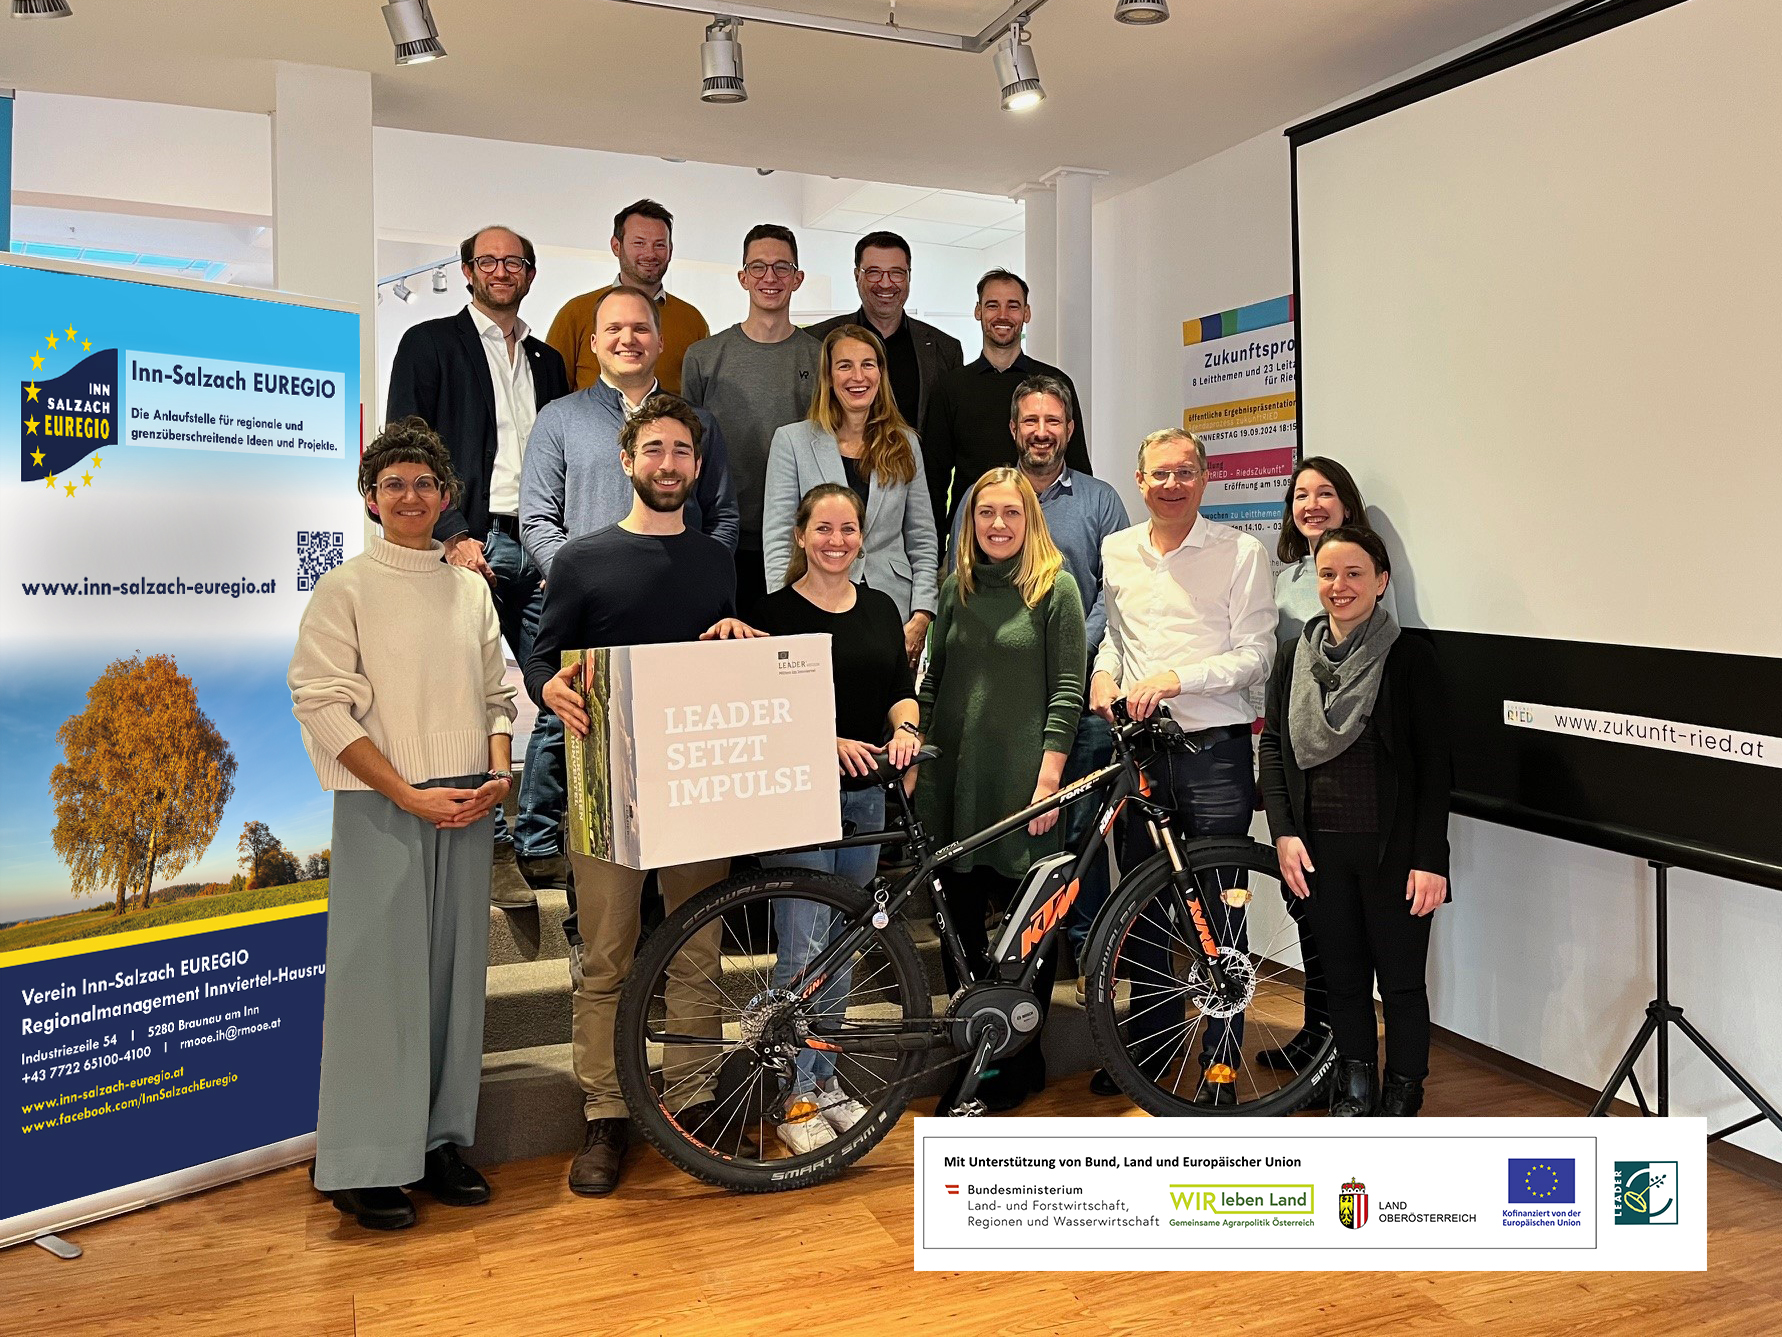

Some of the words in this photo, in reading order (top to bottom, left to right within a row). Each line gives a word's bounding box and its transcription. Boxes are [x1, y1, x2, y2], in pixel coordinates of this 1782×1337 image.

[1204, 339, 1295, 368] Zukunftspro
[89, 382, 110, 396] INN
[132, 360, 246, 391] Inn-Salzach
[254, 372, 336, 399] EUREGIO
[1192, 378, 1197, 387] 8
[1200, 371, 1243, 386] Leitthemen
[1246, 366, 1261, 377] und
[1264, 364, 1274, 374] 23
[1264, 376, 1278, 385] für
[47, 397, 110, 414] SALZACH
[131, 408, 149, 420] Die
[153, 409, 216, 426] Anlaufstelle
[219, 414, 234, 427] für
[236, 416, 282, 431] regionale
[285, 419, 303, 432] und
[1188, 410, 1222, 422] öffentliche
[45, 415, 110, 440] EUREGIO
[131, 428, 244, 445] grenzüberschreitende
[247, 433, 273, 447] Ideen
[277, 437, 295, 449] und
[298, 438, 338, 453] Projekte.
[1199, 430, 1238, 442] ONNERSTAG
[1240, 425, 1277, 438] 19.09.2024
[1224, 481, 1258, 491] Eröffnung
[1241, 509, 1281, 519] Leitthemen
[22, 577, 276, 598] www.inn-salzach-euregio.at
[778, 661, 806, 669] LEADER
[664, 697, 792, 735] LEADER
[1508, 710, 1533, 723] RIED
[1554, 714, 1764, 758] www.zukunft-ried.at
[666, 734, 768, 771] SETZT
[668, 764, 812, 807] IMPULSE
[682, 881, 794, 929] SCHWALBE
[1021, 877, 1080, 960] KTM
[1098, 900, 1136, 1003] SCHWALBE
[22, 983, 77, 1006] Verein
[83, 963, 175, 996] Inn-Salzach
[181, 949, 249, 977] EUREGIO
[22, 987, 200, 1036] Regionalmanagement
[205, 964, 326, 999] Innviertel-Hausru
[22, 1038, 100, 1065] Industriezeile
[103, 1033, 117, 1047] 54
[148, 1022, 175, 1038] 5280
[178, 1014, 222, 1032] Braunau
[225, 1011, 241, 1023] am
[244, 1005, 260, 1019] Inn
[22, 1069, 47, 1084] +43
[50, 1062, 80, 1079] 7722
[83, 1046, 152, 1072] 65100-4100
[180, 1017, 282, 1050] rmooe.ih@rmooe.at
[22, 1066, 184, 1115] www.inn-salzach-euregio.at
[22, 1072, 238, 1134] www.facebook.com/InnSalzachEuregio
[771, 1154, 835, 1181] SMART
[841, 1124, 876, 1156] SAM
